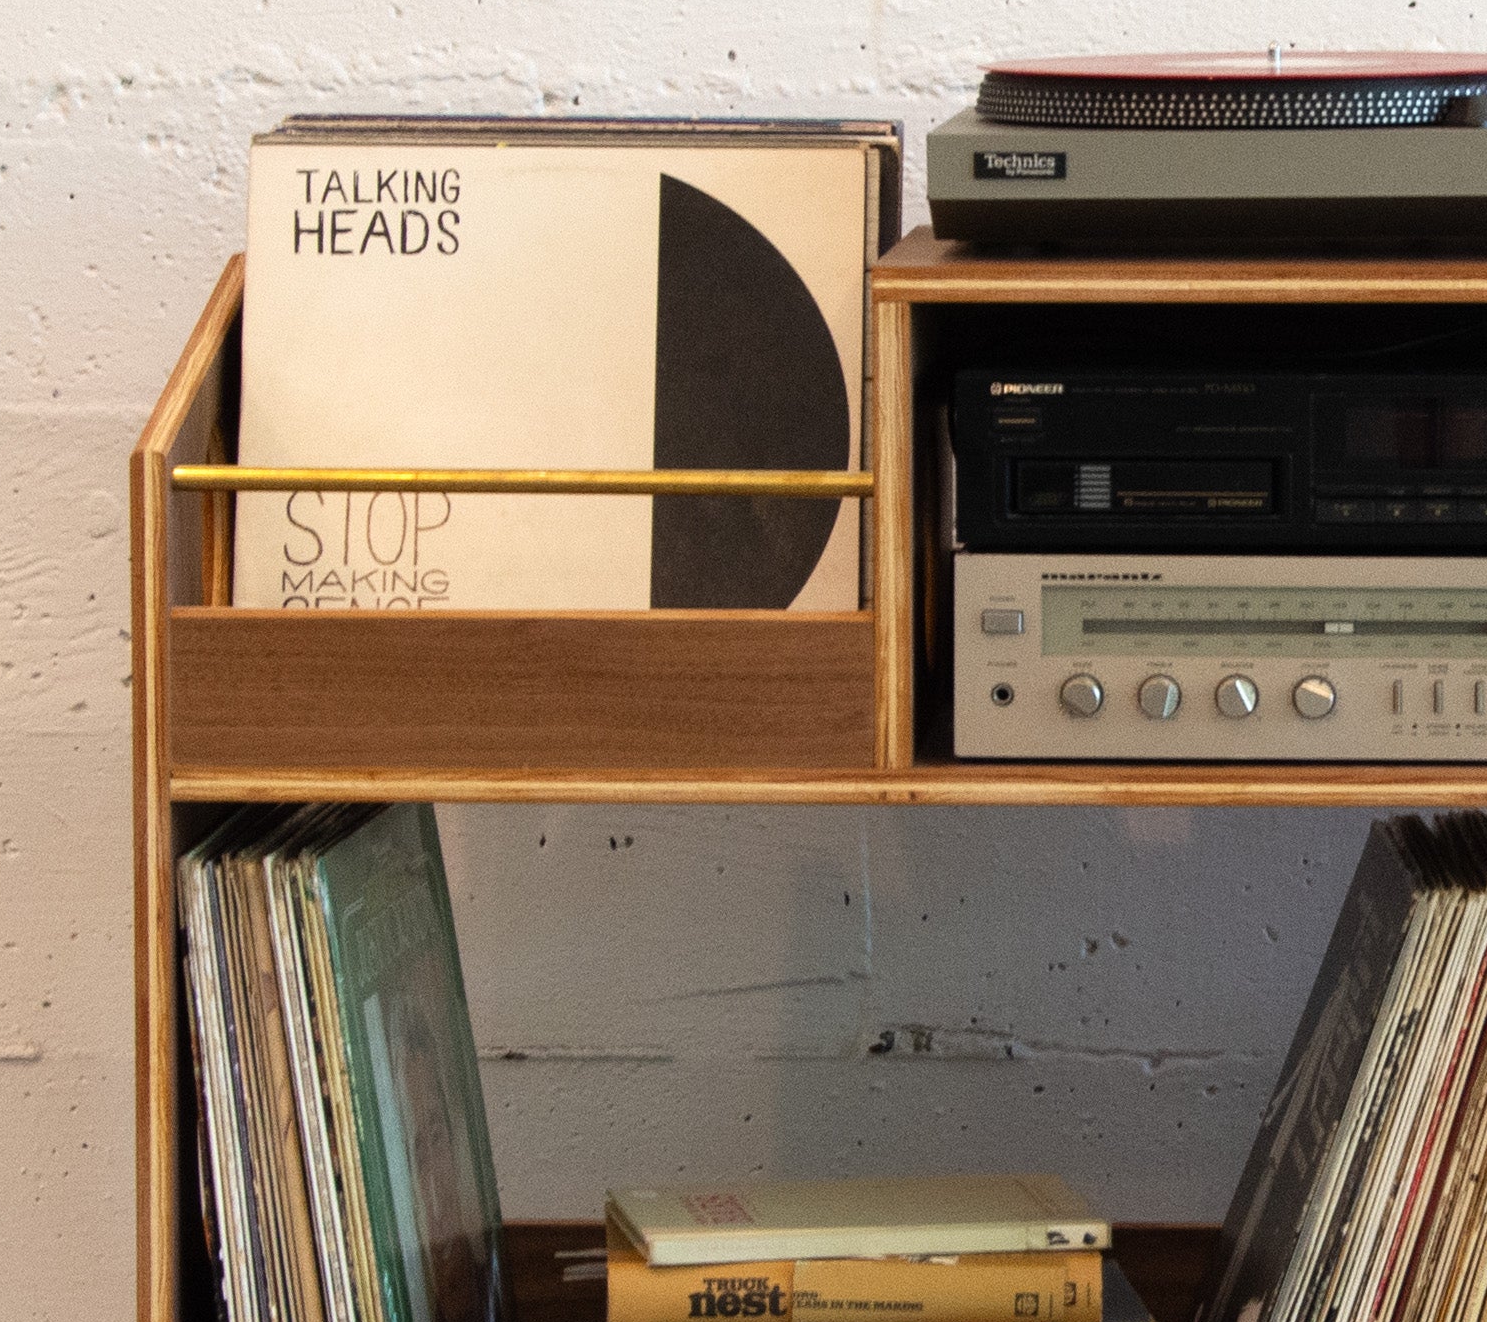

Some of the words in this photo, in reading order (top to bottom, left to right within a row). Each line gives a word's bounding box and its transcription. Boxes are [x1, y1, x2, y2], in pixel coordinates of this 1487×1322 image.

[984, 153, 1055, 169] Technics
[296, 168, 460, 205] TALKING
[293, 209, 460, 255] HEADS
[282, 569, 450, 595] MAKING
[687, 1282, 787, 1318] nest
